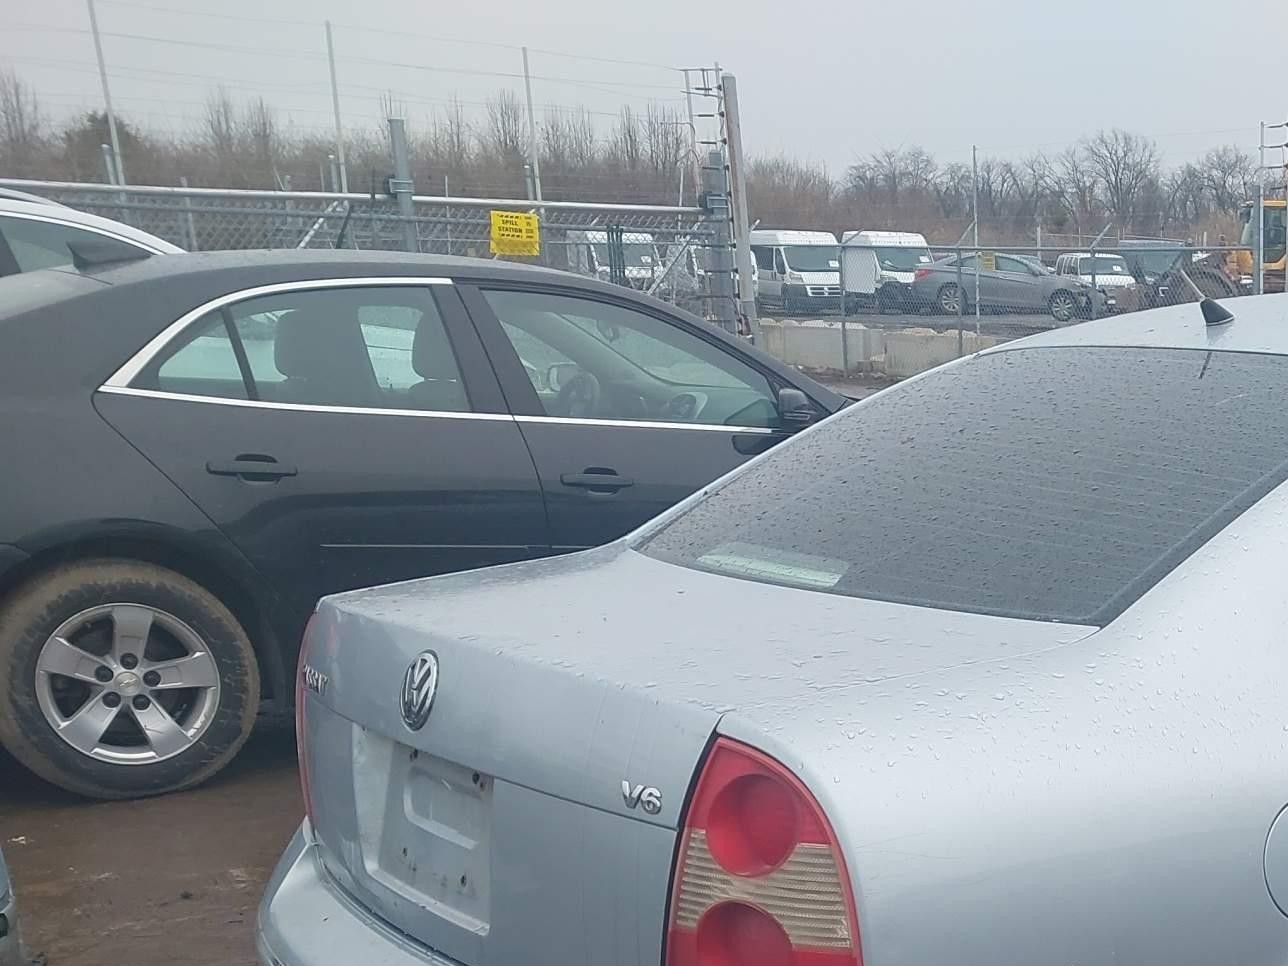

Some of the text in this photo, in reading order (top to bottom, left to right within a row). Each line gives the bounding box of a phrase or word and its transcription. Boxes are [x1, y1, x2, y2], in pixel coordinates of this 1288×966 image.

[501, 218, 519, 226] SPILL
[497, 226, 523, 234] STATION
[621, 779, 663, 816] V6
